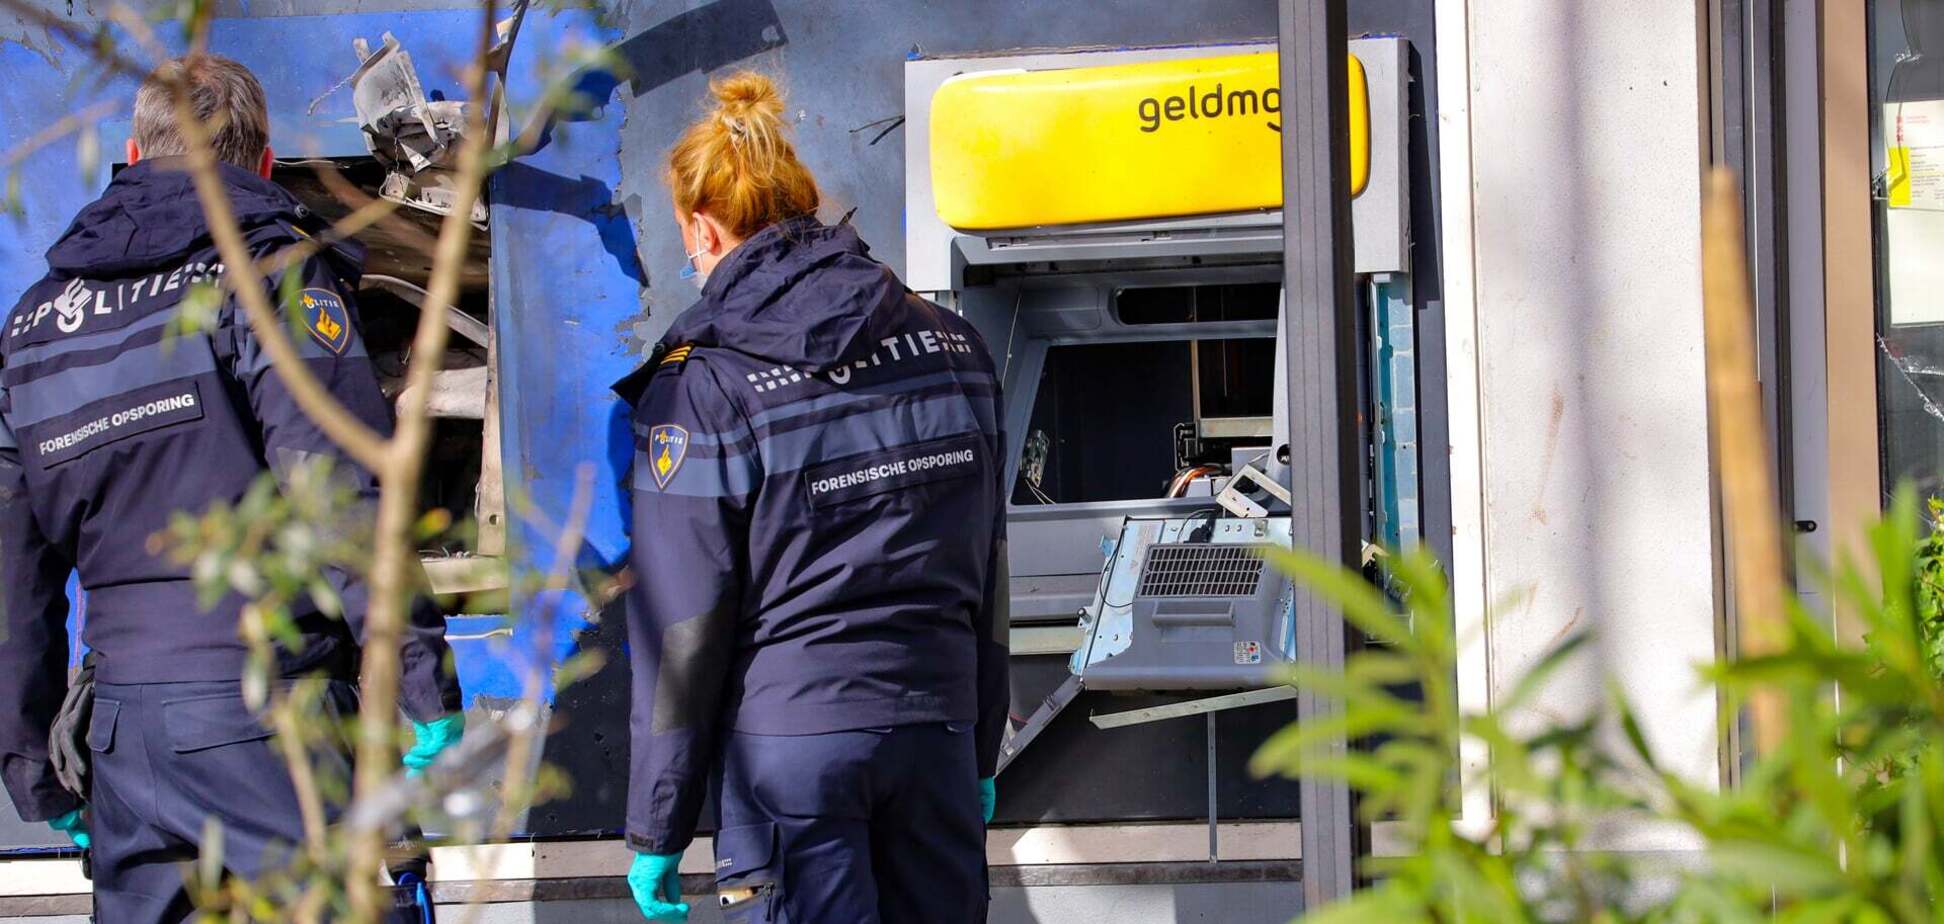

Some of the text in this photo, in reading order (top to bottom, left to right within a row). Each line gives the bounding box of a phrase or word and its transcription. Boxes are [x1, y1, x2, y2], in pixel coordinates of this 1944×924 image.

[32, 266, 184, 334] POLITIE
[39, 393, 195, 456] FORENSISCHE OPSPORING
[811, 449, 974, 495] FORENSISCHE OPSPORING
